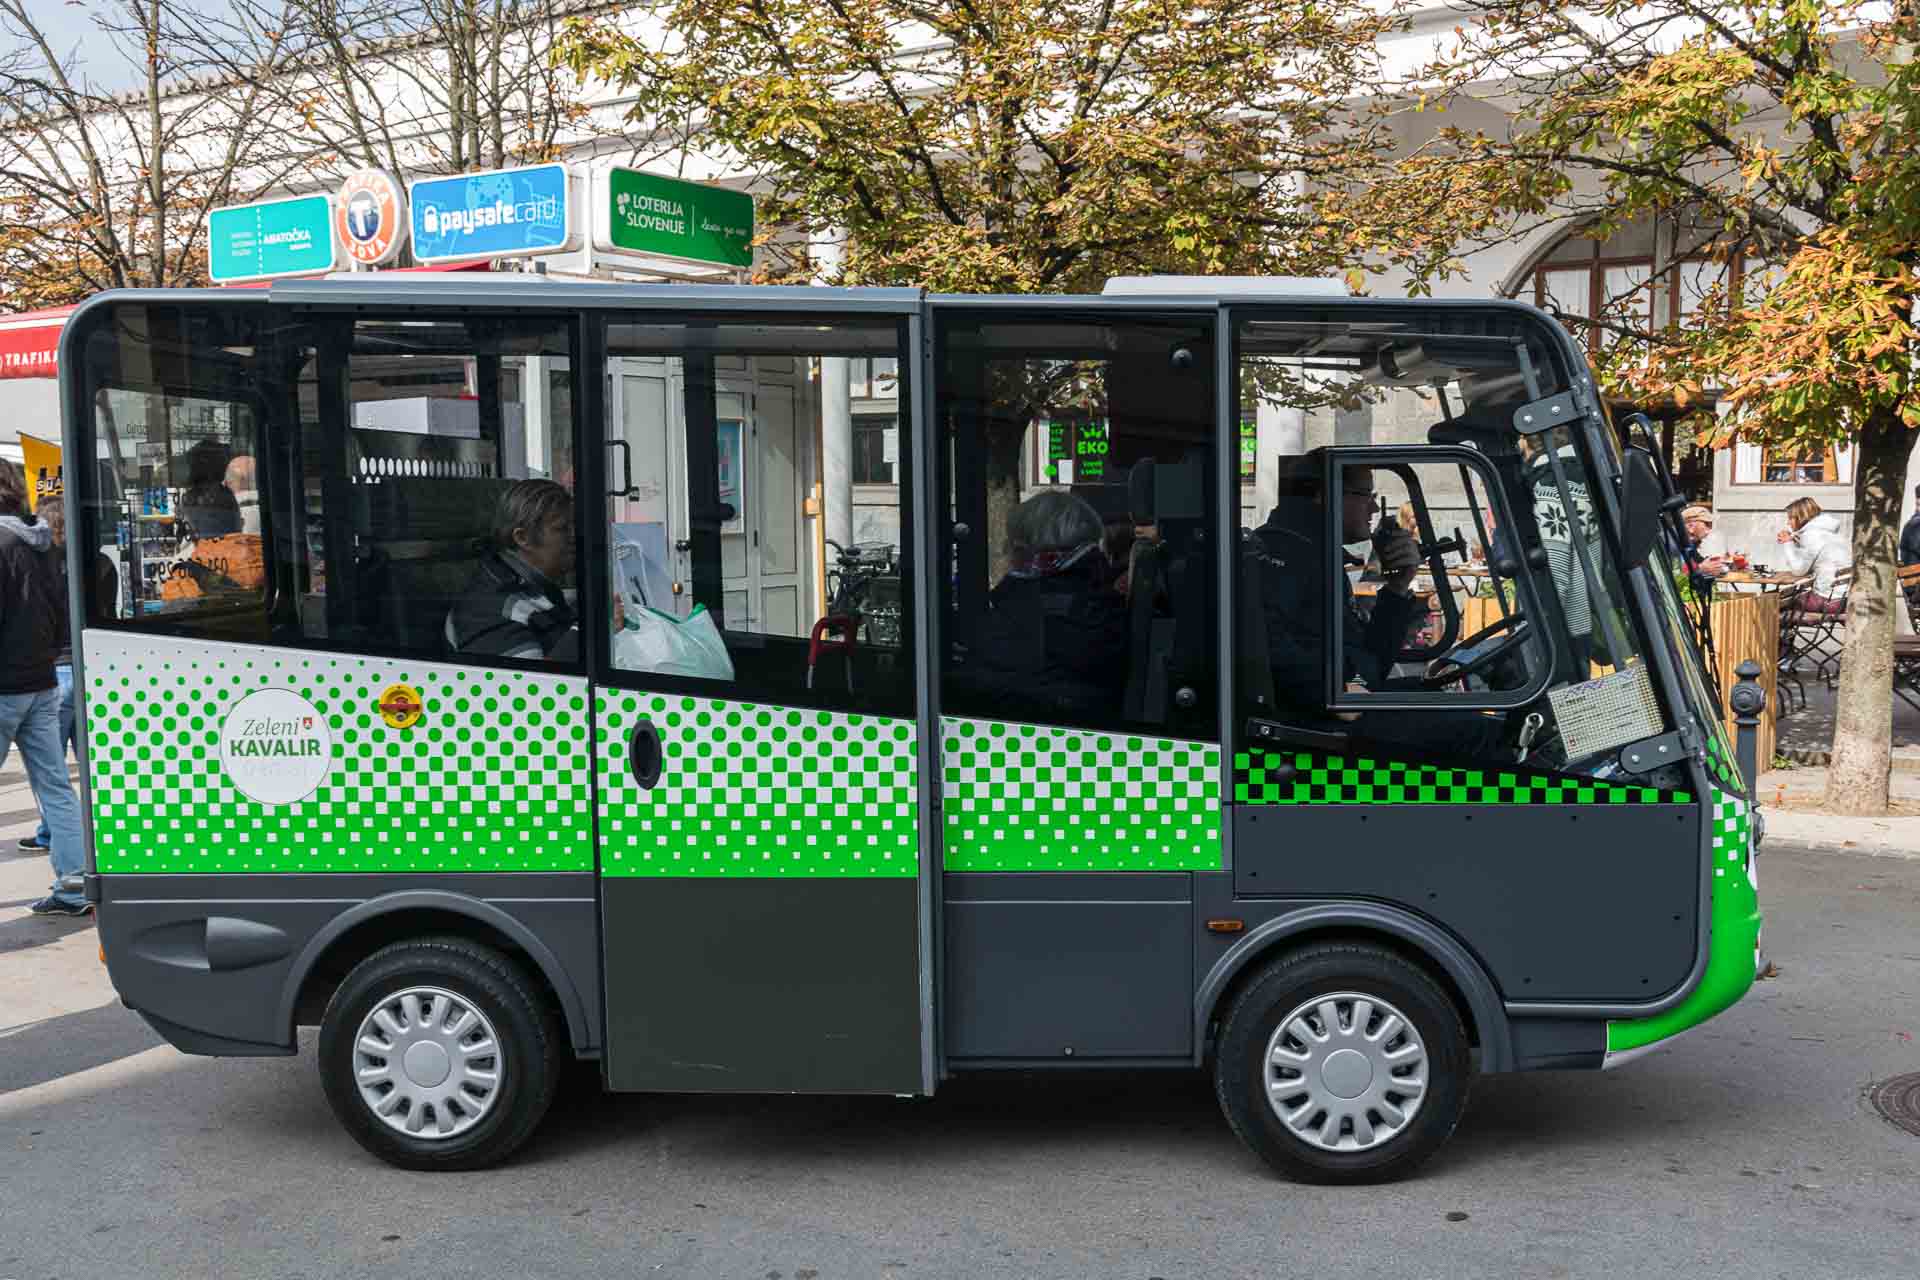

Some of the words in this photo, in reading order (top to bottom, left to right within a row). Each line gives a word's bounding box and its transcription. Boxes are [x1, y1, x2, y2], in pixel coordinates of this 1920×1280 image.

[440, 194, 556, 237] paysafecard
[632, 194, 684, 217] LOTERIJA
[626, 209, 685, 235] SLOVENIJE
[1077, 441, 1109, 455] EKO
[242, 716, 300, 736] Zeleni
[229, 738, 321, 757] KAVALIR
